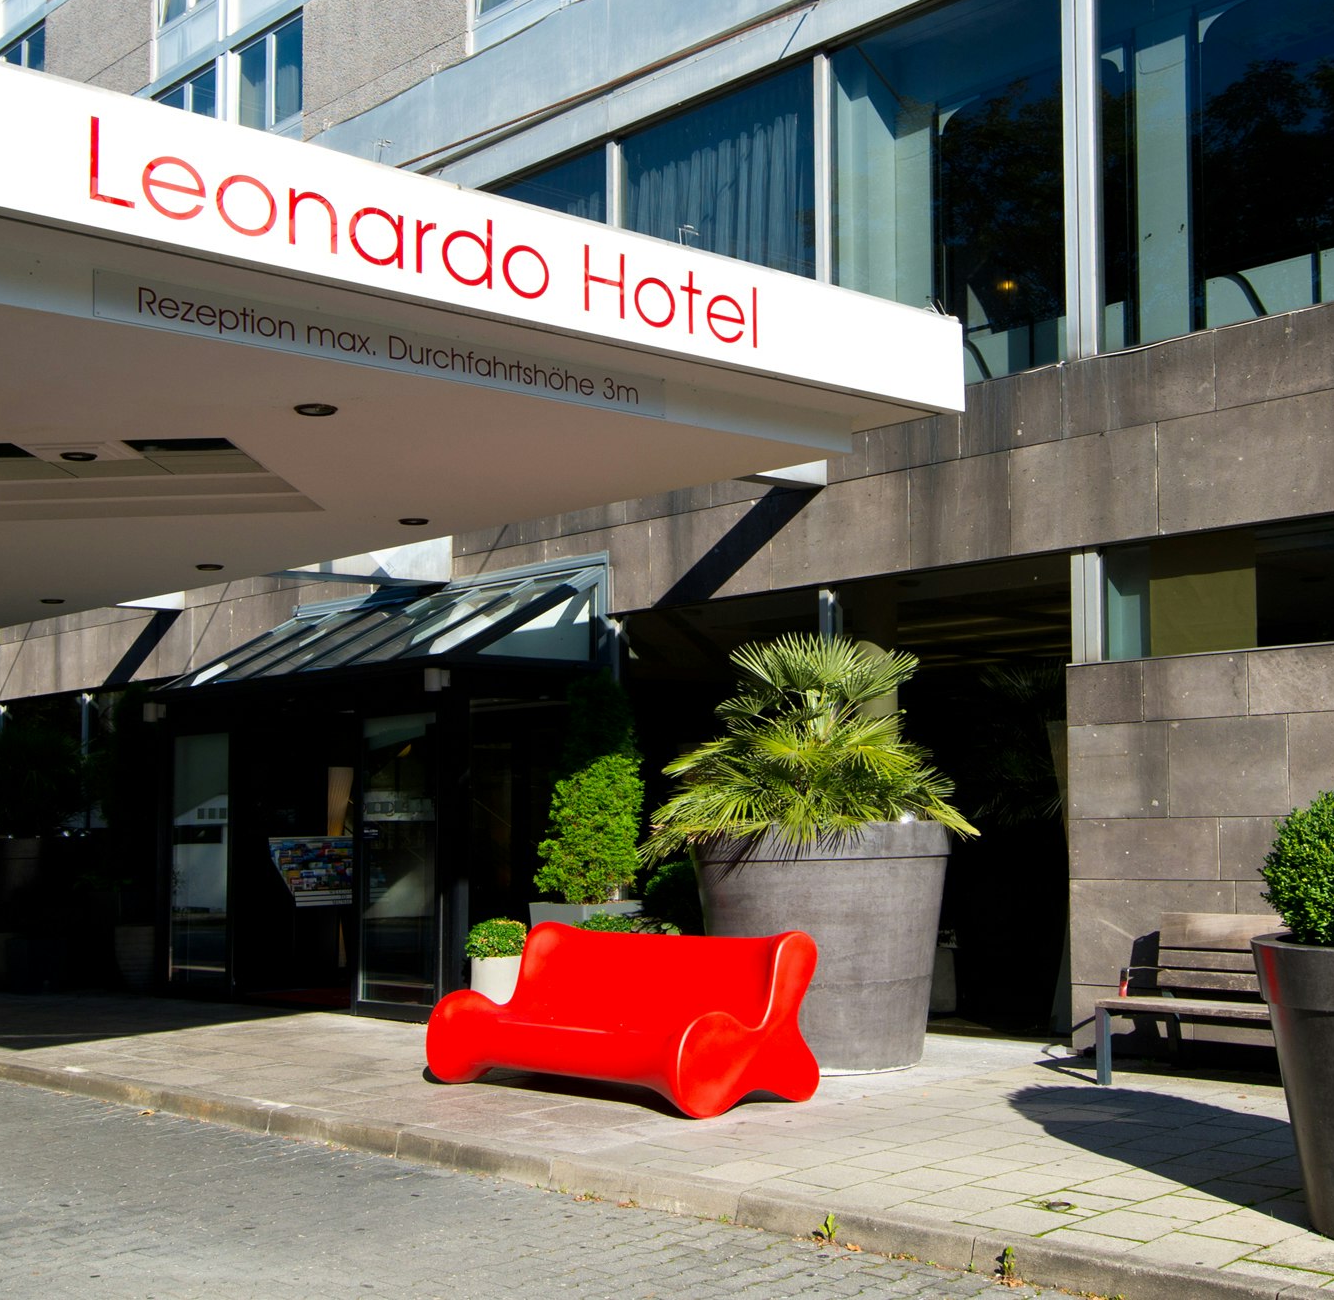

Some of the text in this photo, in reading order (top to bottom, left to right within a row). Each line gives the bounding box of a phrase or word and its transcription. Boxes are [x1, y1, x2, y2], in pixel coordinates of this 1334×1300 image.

[90, 116, 758, 349] Leonardo Hotel
[138, 286, 639, 404] Rezeption max. Durchfahrtshöhe 3m
